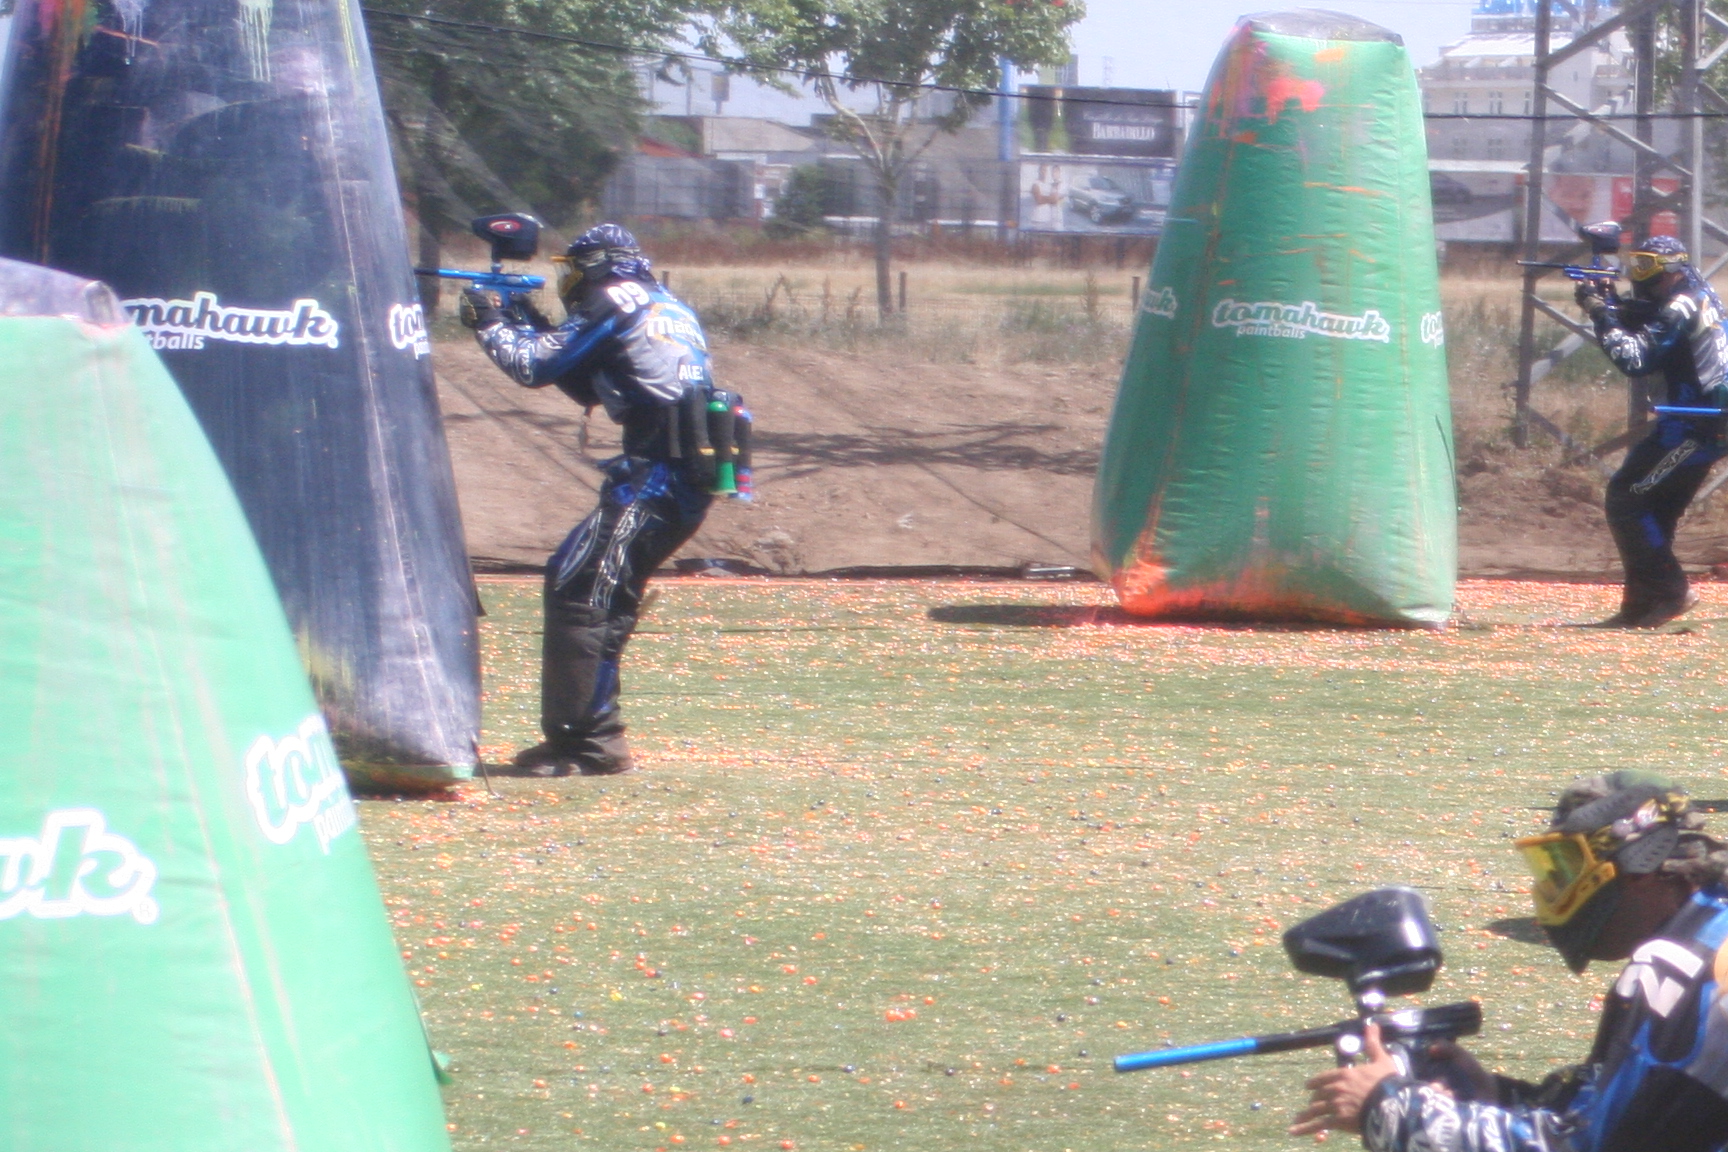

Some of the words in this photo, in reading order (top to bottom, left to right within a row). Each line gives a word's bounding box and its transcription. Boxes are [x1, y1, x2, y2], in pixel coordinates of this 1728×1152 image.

[120, 290, 339, 348] mahawk
[607, 281, 650, 314] 09
[1212, 299, 1390, 343] tomahawk
[1236, 324, 1306, 340] paintballs
[1615, 938, 1704, 1018] 21
